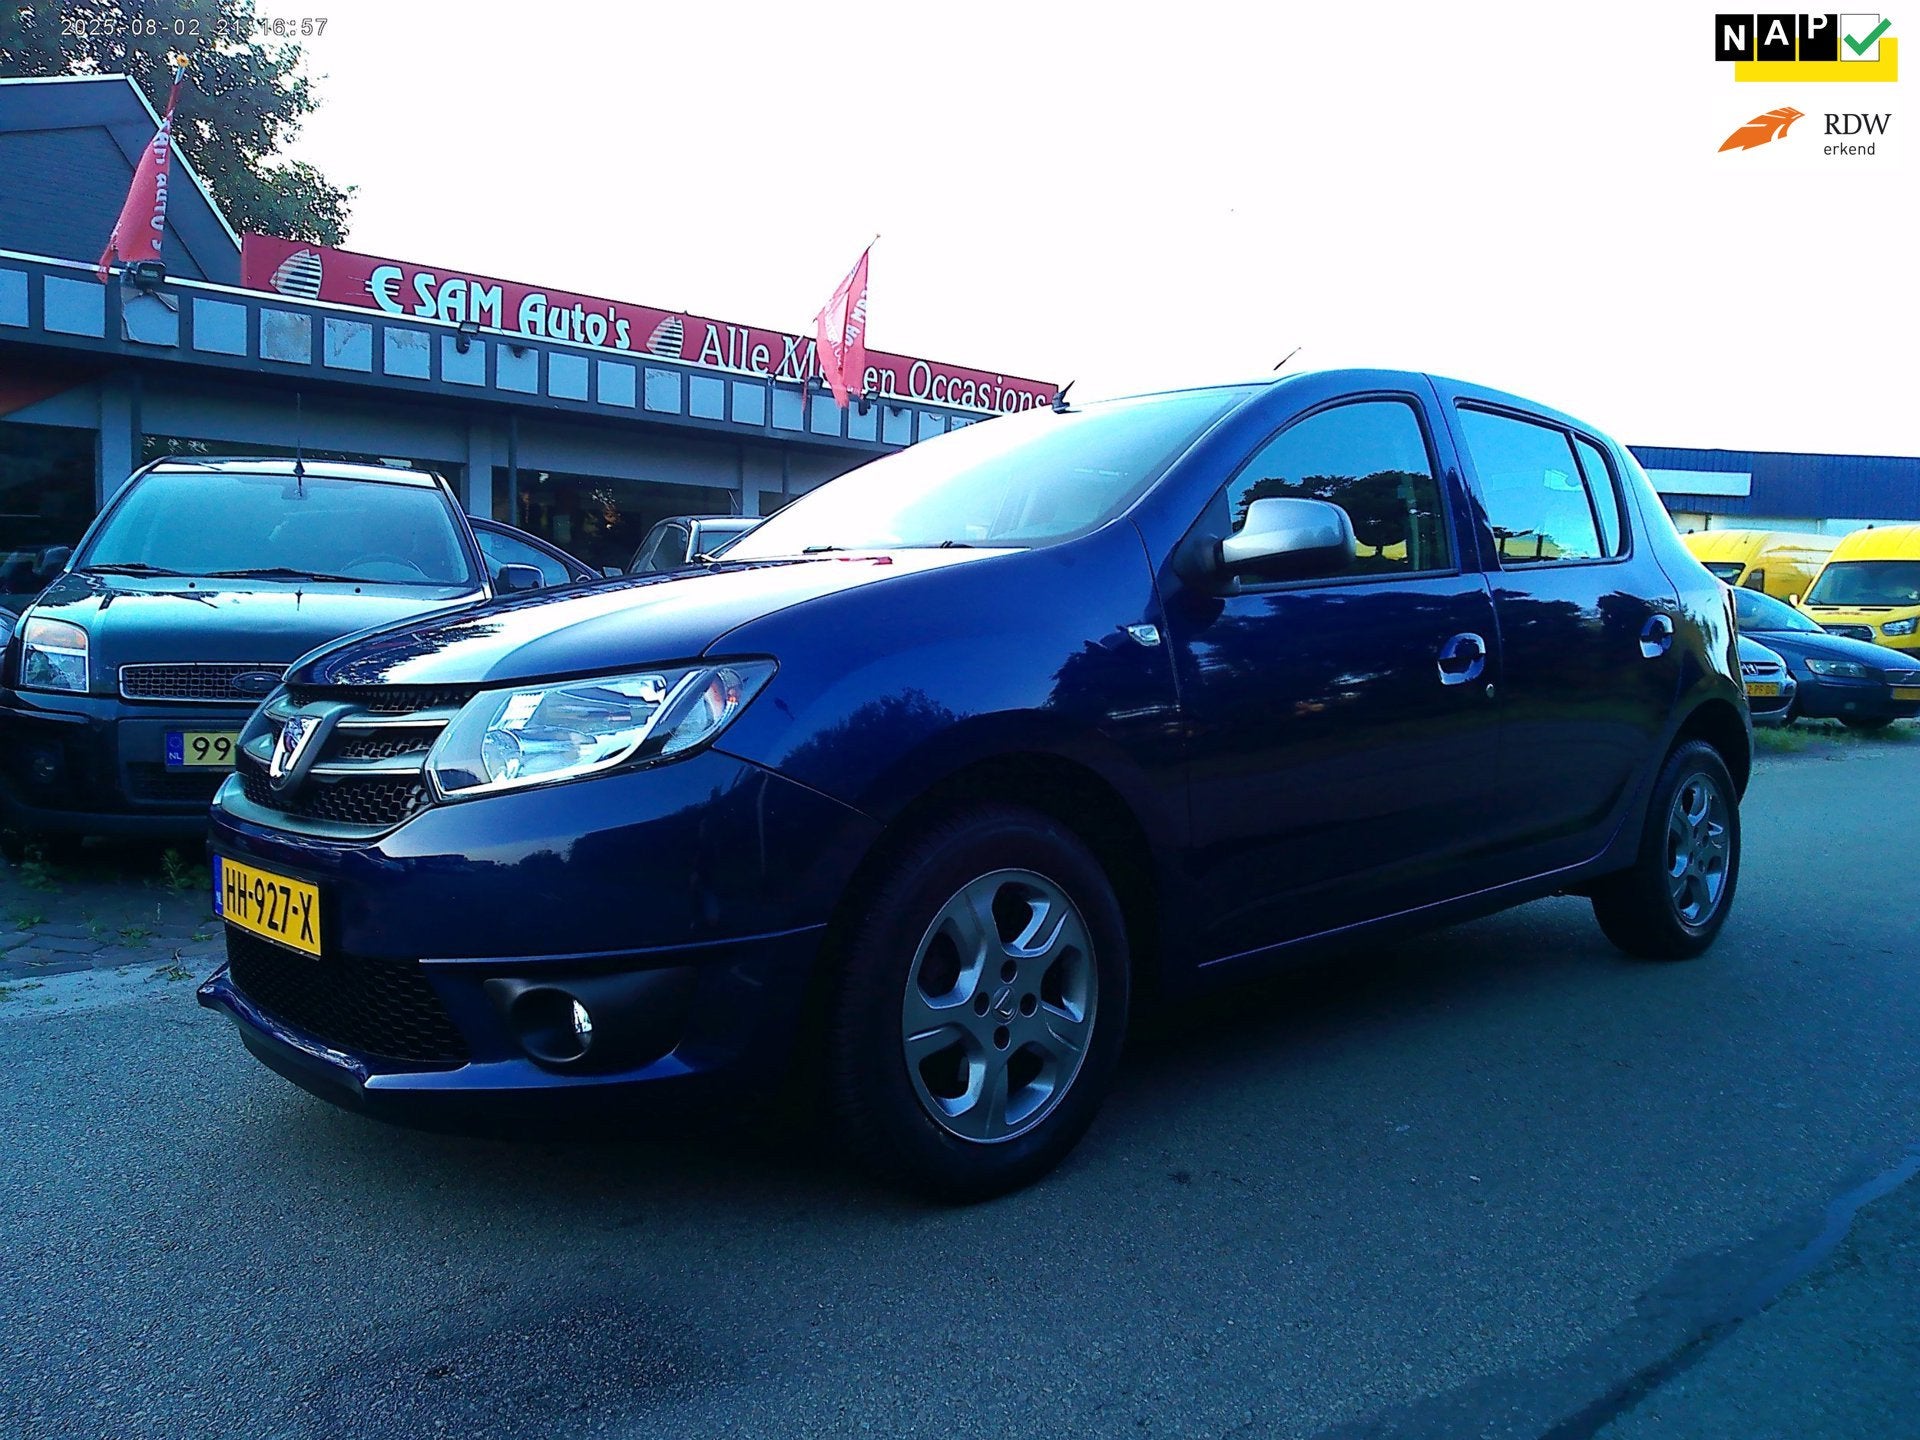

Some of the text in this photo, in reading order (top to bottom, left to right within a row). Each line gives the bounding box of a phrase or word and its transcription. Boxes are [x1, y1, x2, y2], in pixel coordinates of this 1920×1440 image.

[412, 272, 503, 331] SAM
[518, 293, 631, 350] Auto's
[698, 323, 771, 374] Alle
[780, 335, 896, 398] Men
[225, 866, 315, 945] HH-927-X
